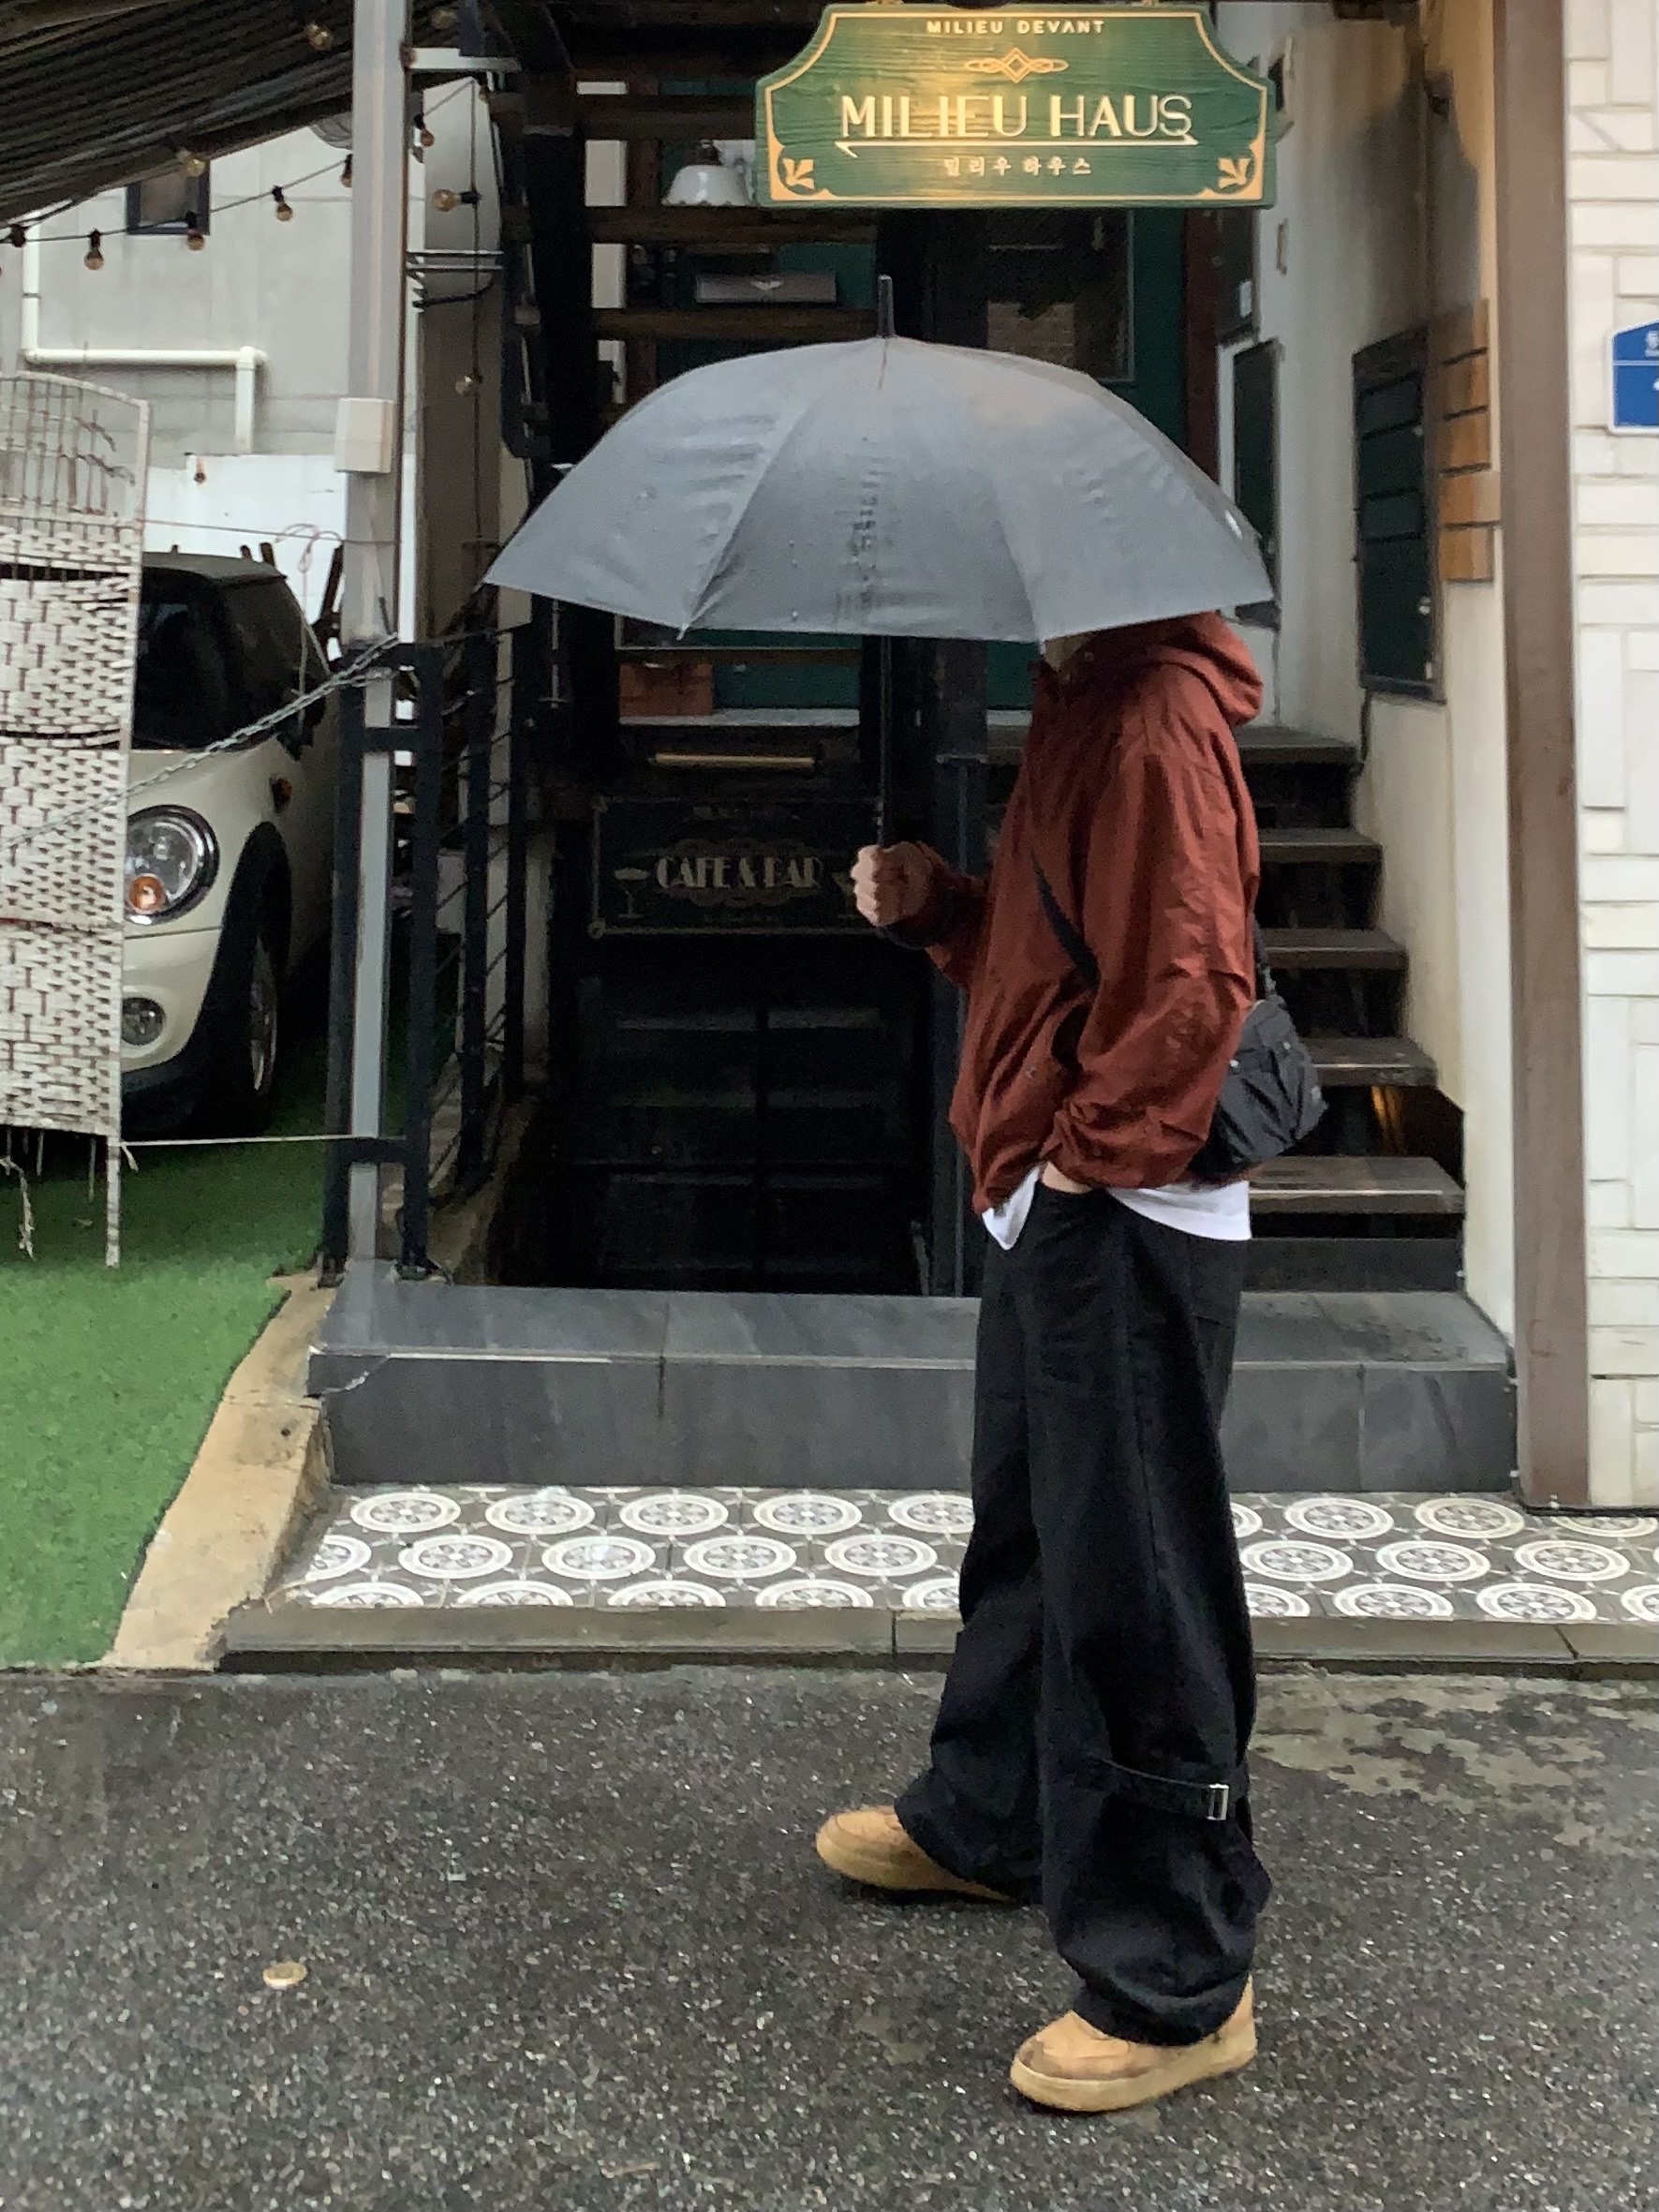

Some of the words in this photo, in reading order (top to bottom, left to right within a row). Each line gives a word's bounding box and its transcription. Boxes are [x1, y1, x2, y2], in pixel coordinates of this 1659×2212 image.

[926, 20, 1003, 35] MILIEU
[1016, 20, 1104, 35] DEVANT
[842, 95, 1027, 138] MILIEU
[1049, 94, 1193, 138] HAUS
[943, 156, 1012, 177] 밀리우
[1021, 156, 1091, 176] 하우스
[655, 855, 731, 889] CAFE
